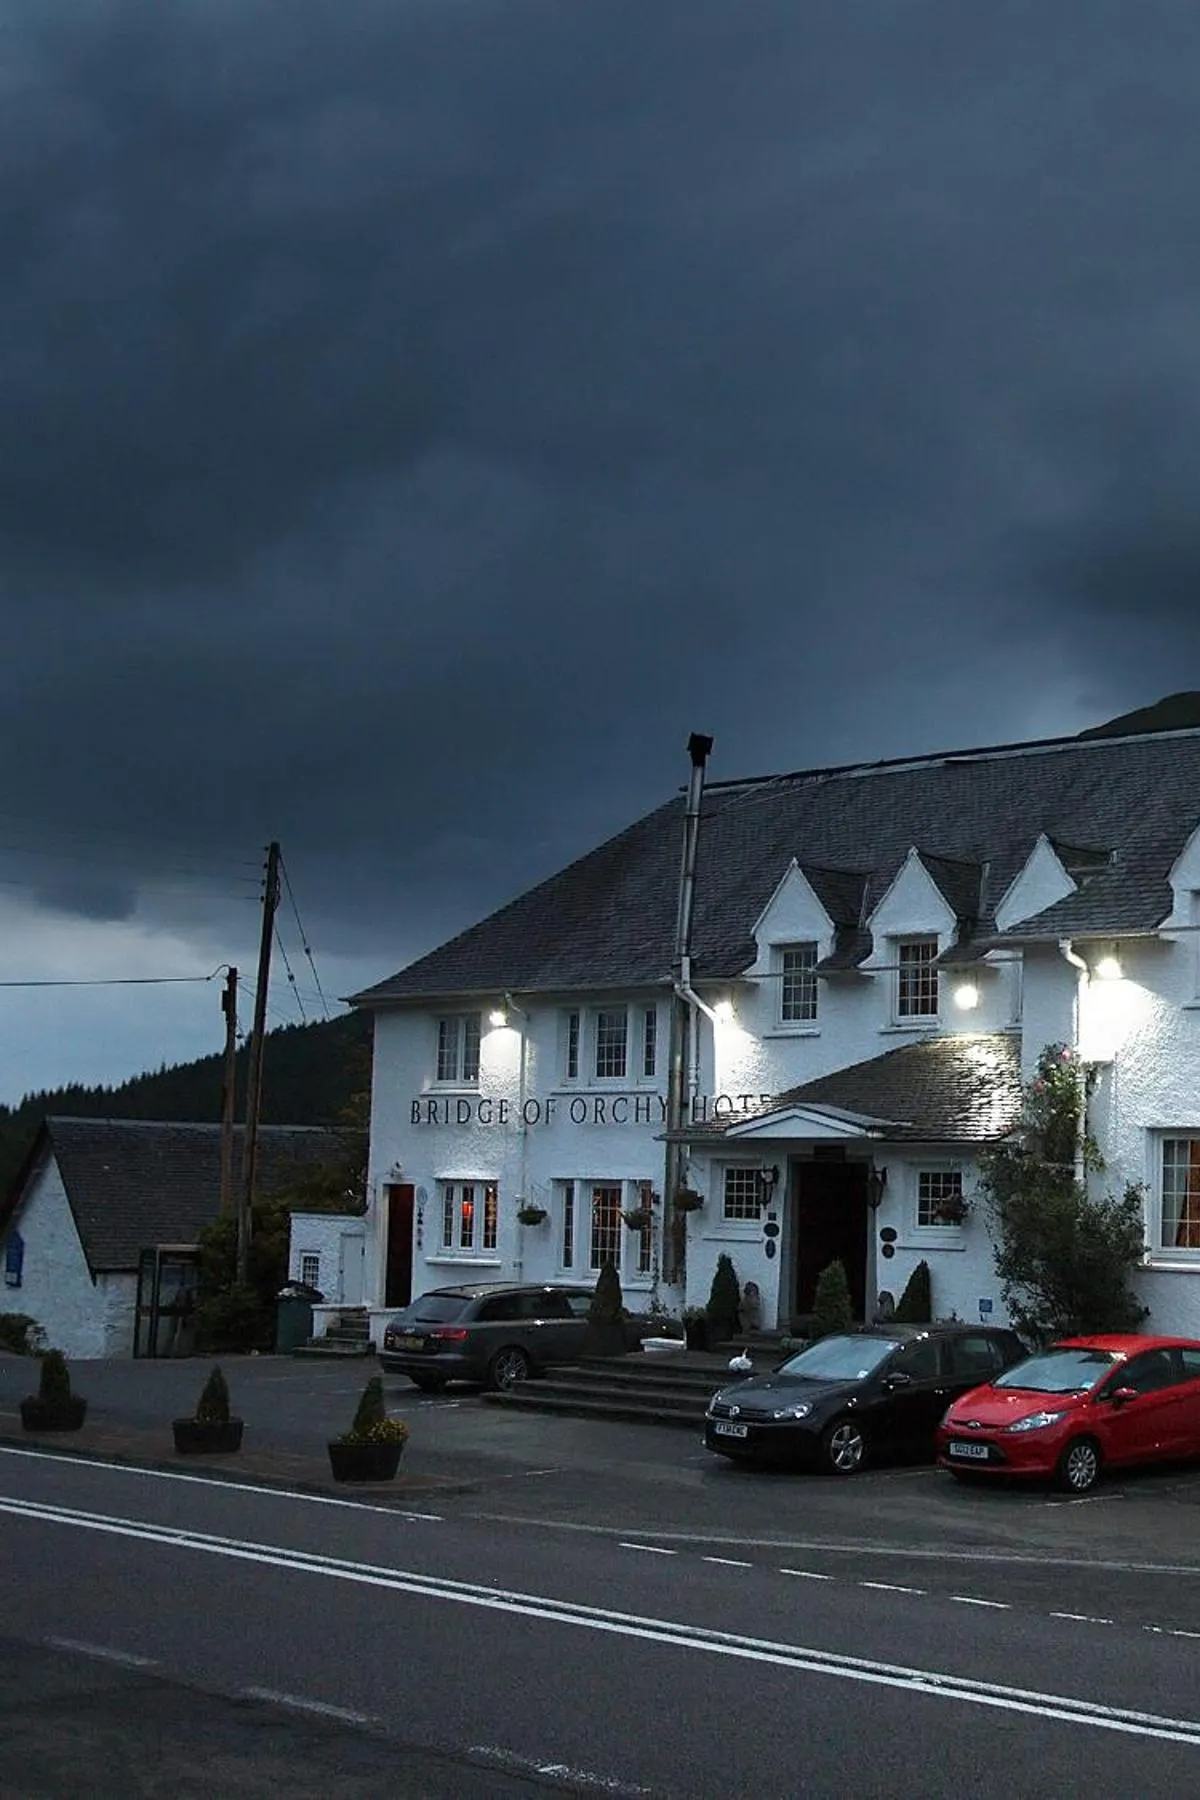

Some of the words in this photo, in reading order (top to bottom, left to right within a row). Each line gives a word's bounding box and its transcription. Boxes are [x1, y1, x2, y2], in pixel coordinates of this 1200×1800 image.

[410, 1099, 509, 1124] BRIDGE
[523, 1099, 557, 1125] OF
[569, 1096, 667, 1124] ORCHY
